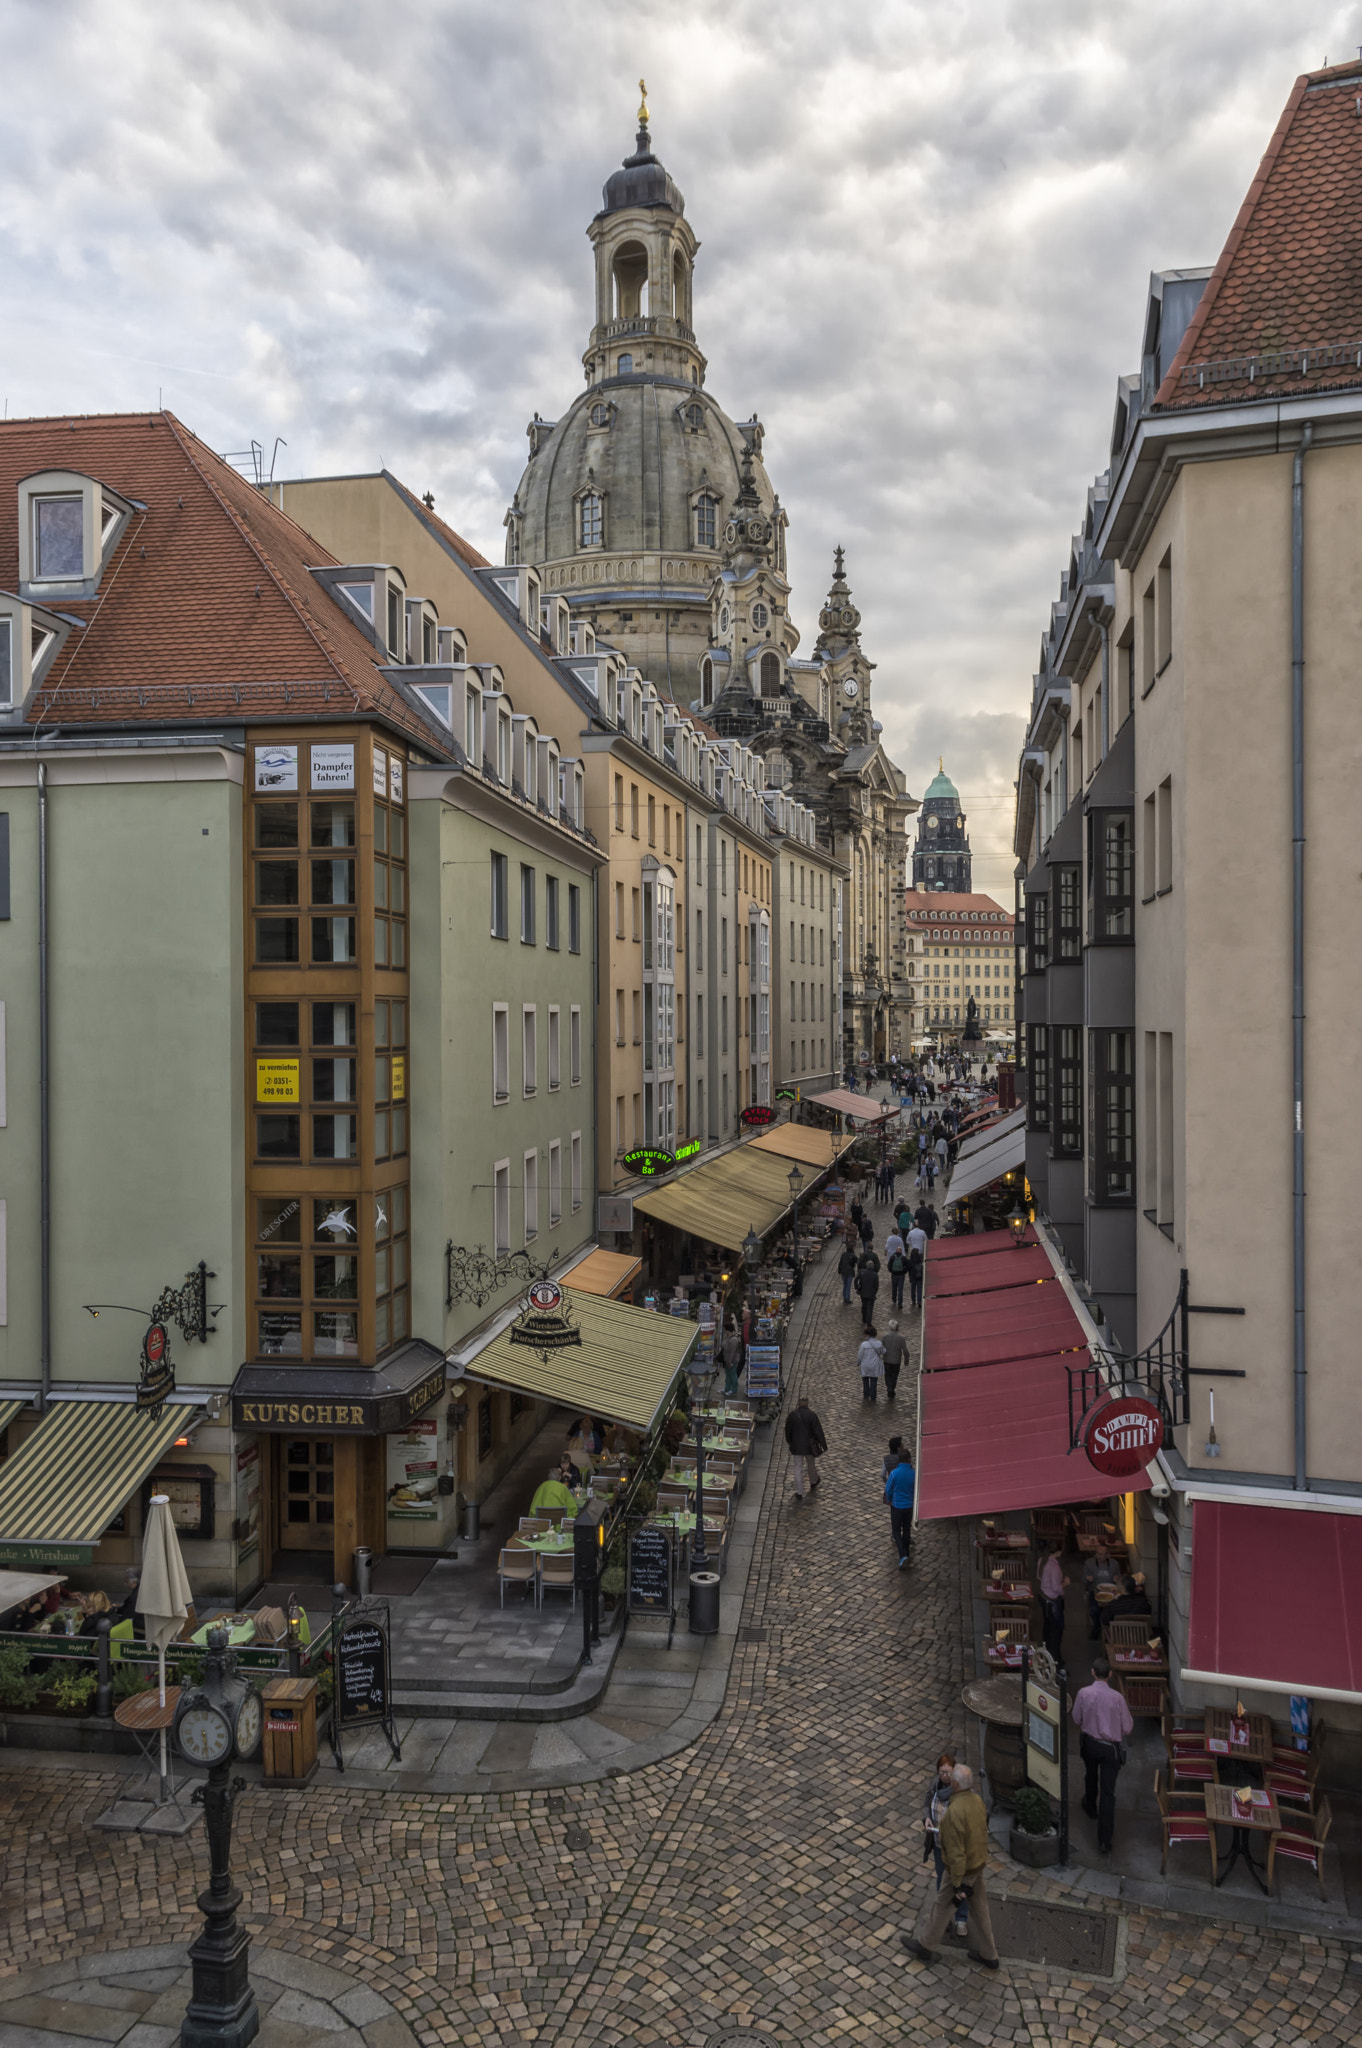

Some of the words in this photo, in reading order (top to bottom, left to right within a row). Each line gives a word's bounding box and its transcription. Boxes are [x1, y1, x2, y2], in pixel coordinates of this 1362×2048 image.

[313, 762, 353, 773] Dampfer
[317, 772, 349, 782] fahren!
[273, 1077, 292, 1085] 0351-
[744, 1108, 771, 1117] AYERS
[625, 1150, 671, 1163] Restaurant
[645, 1158, 652, 1166] &
[642, 1166, 655, 1174] Bar
[259, 1201, 300, 1240] DRESCHER
[532, 1283, 559, 1295] ERDINGER
[529, 1320, 563, 1330] Wirtshaus
[513, 1332, 578, 1345] Kutscherschänke
[242, 1403, 365, 1425] KUTSCHER
[1108, 1414, 1148, 1432] DAMPF
[1094, 1418, 1159, 1454] SCHIFF
[29, 1548, 80, 1561] Wirtshaus
